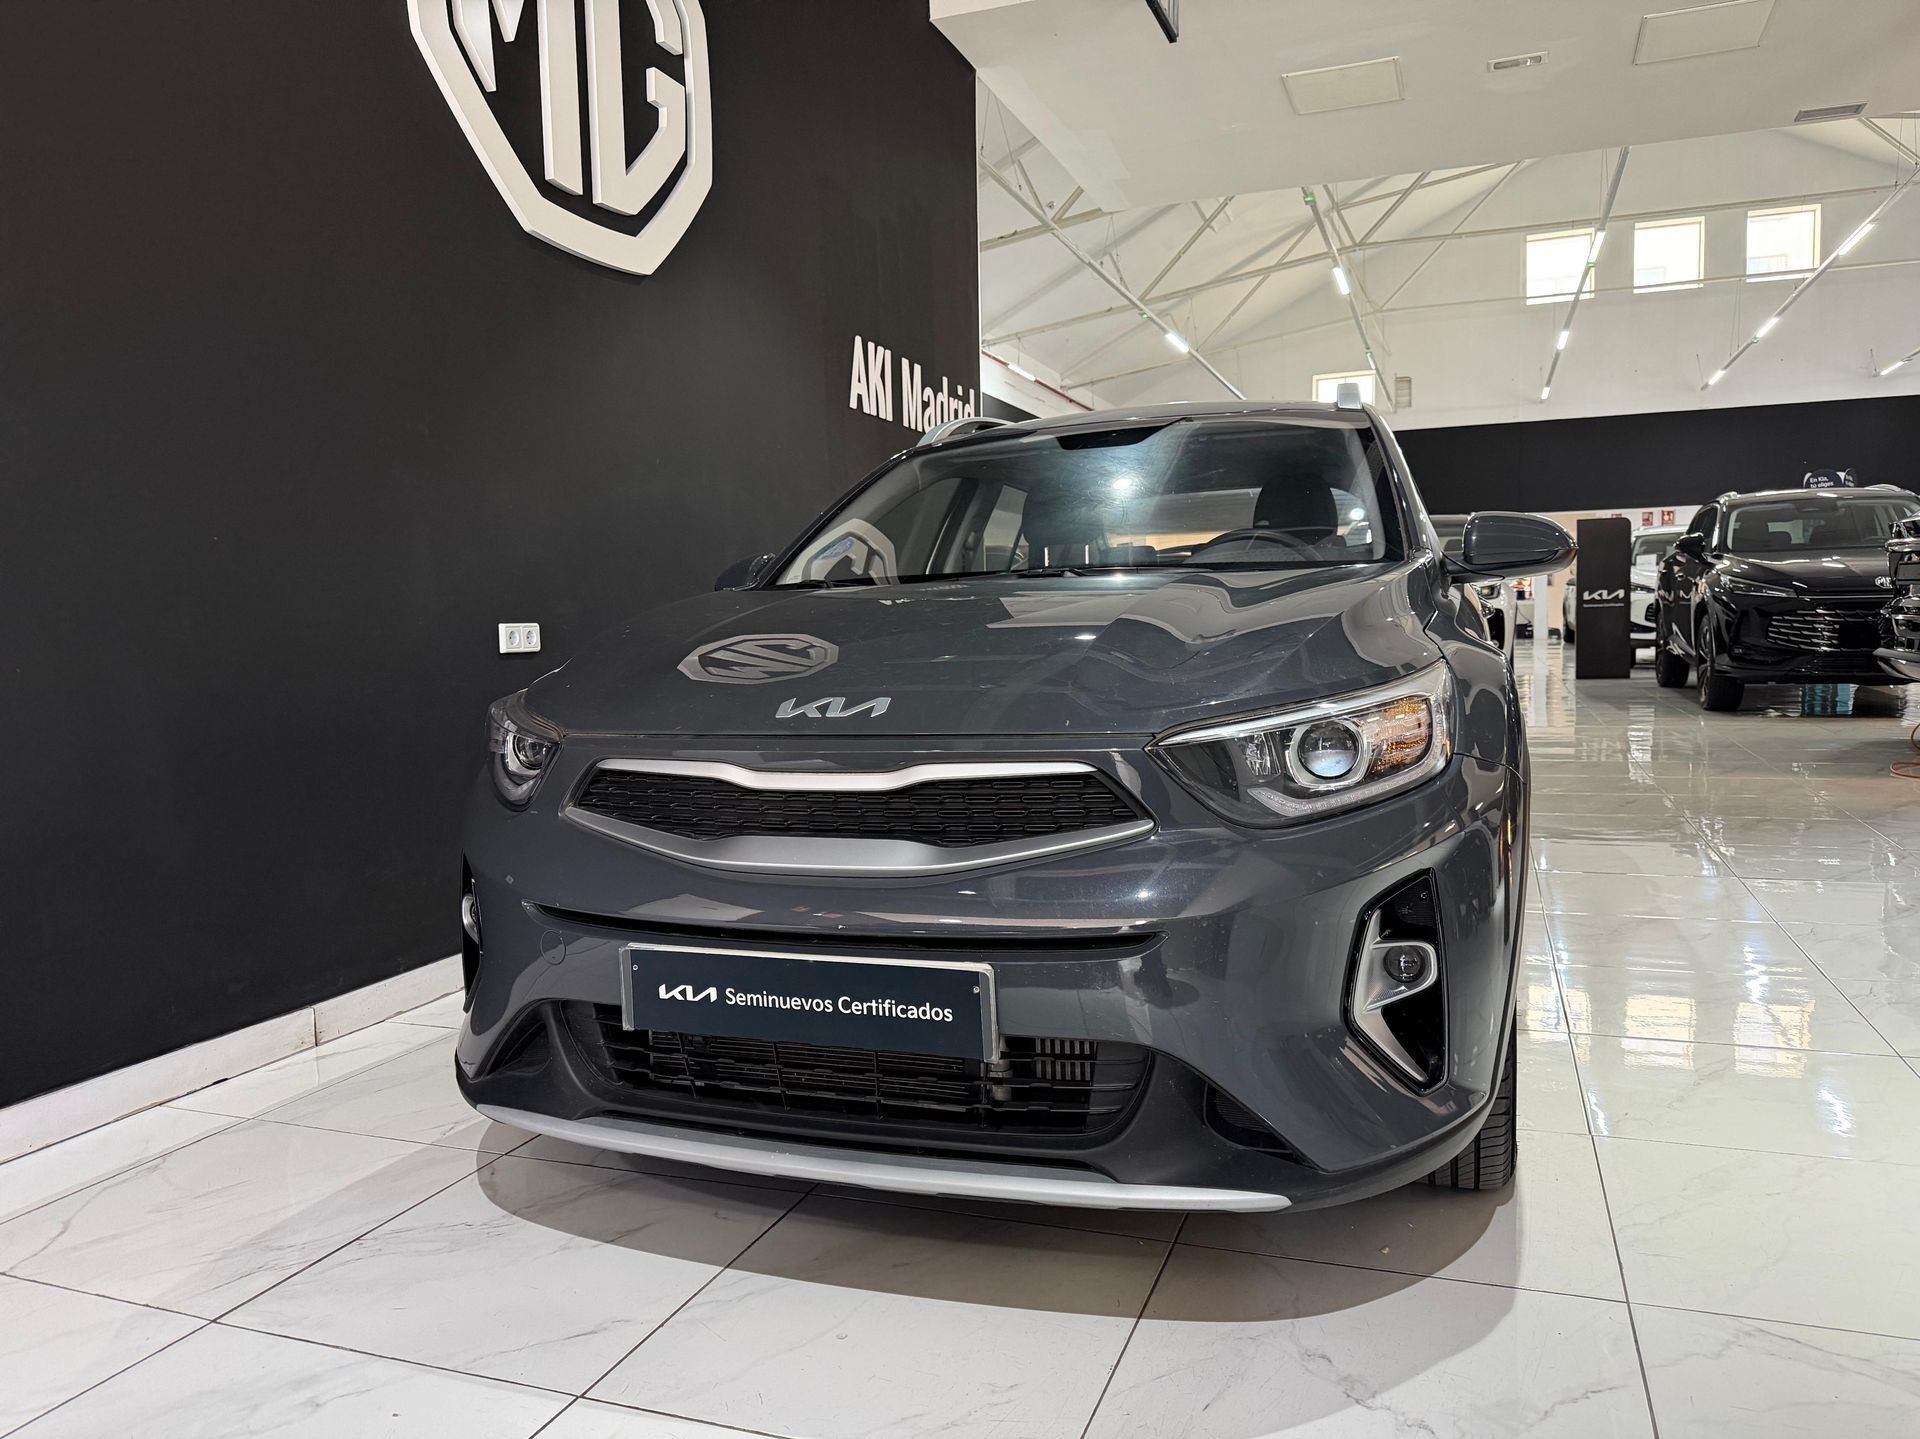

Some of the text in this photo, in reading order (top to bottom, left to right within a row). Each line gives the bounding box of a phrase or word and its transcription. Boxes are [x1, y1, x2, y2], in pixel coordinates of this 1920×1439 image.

[849, 335, 893, 422] AKI
[1583, 589, 1625, 601] KIA
[775, 697, 892, 718] KIA
[658, 983, 954, 1023] KIA Seminuevos Certificados
